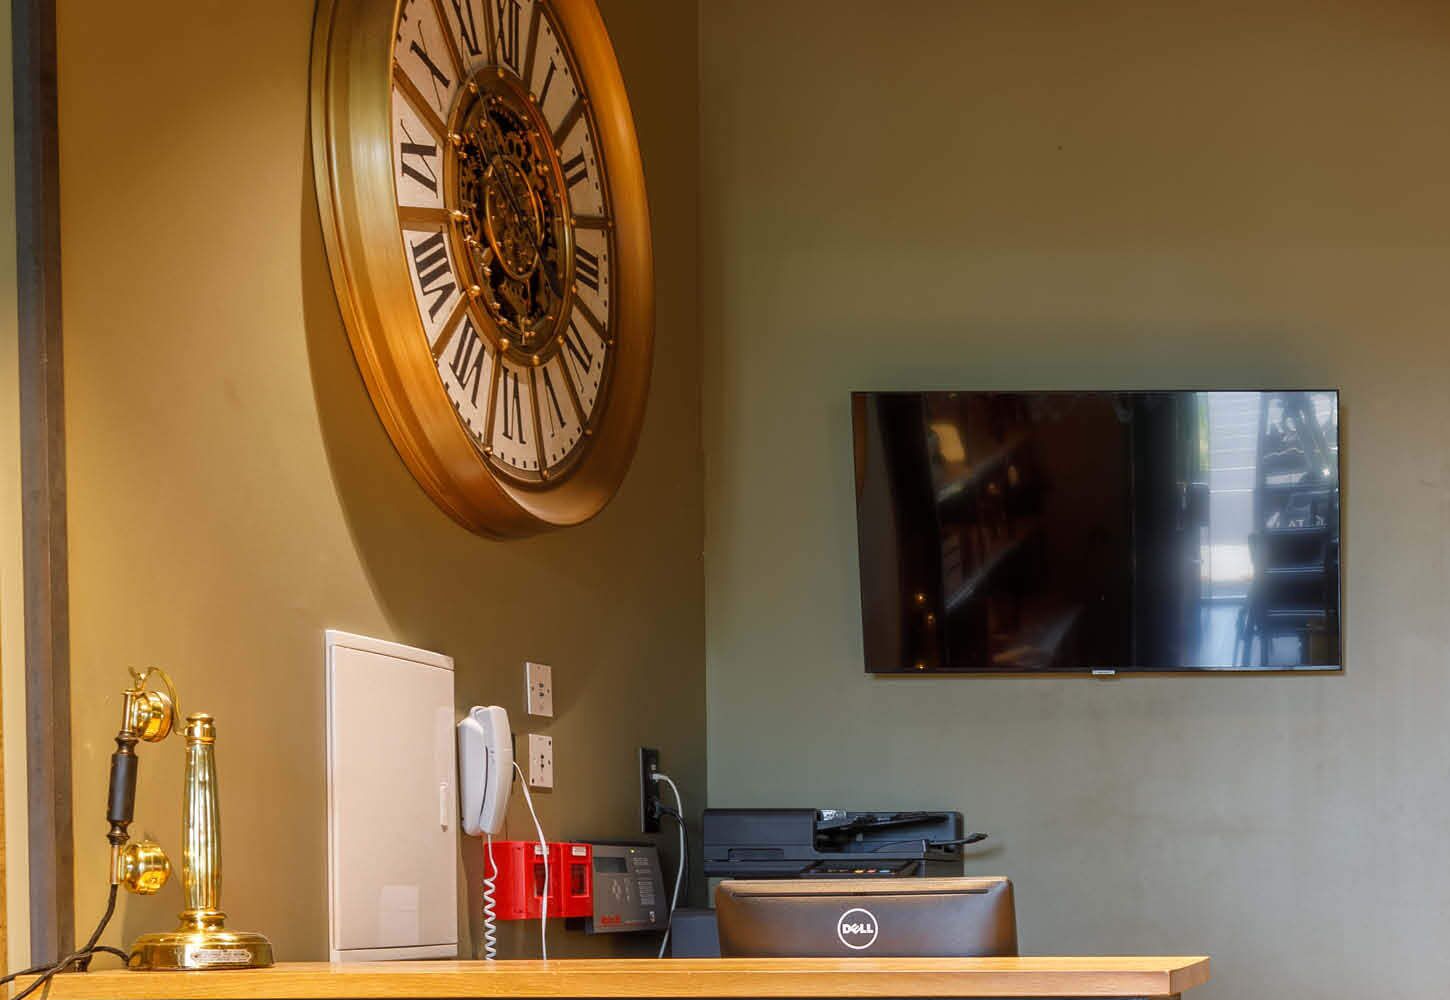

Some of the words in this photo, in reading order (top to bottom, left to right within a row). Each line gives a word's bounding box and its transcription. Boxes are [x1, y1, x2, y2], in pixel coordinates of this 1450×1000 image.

[409, 19, 451, 112] X
[400, 119, 439, 199] IX
[410, 224, 457, 324] VIII
[448, 312, 487, 409] VII
[501, 365, 527, 445] VI
[541, 365, 567, 438] V
[842, 924, 874, 934] DELL
